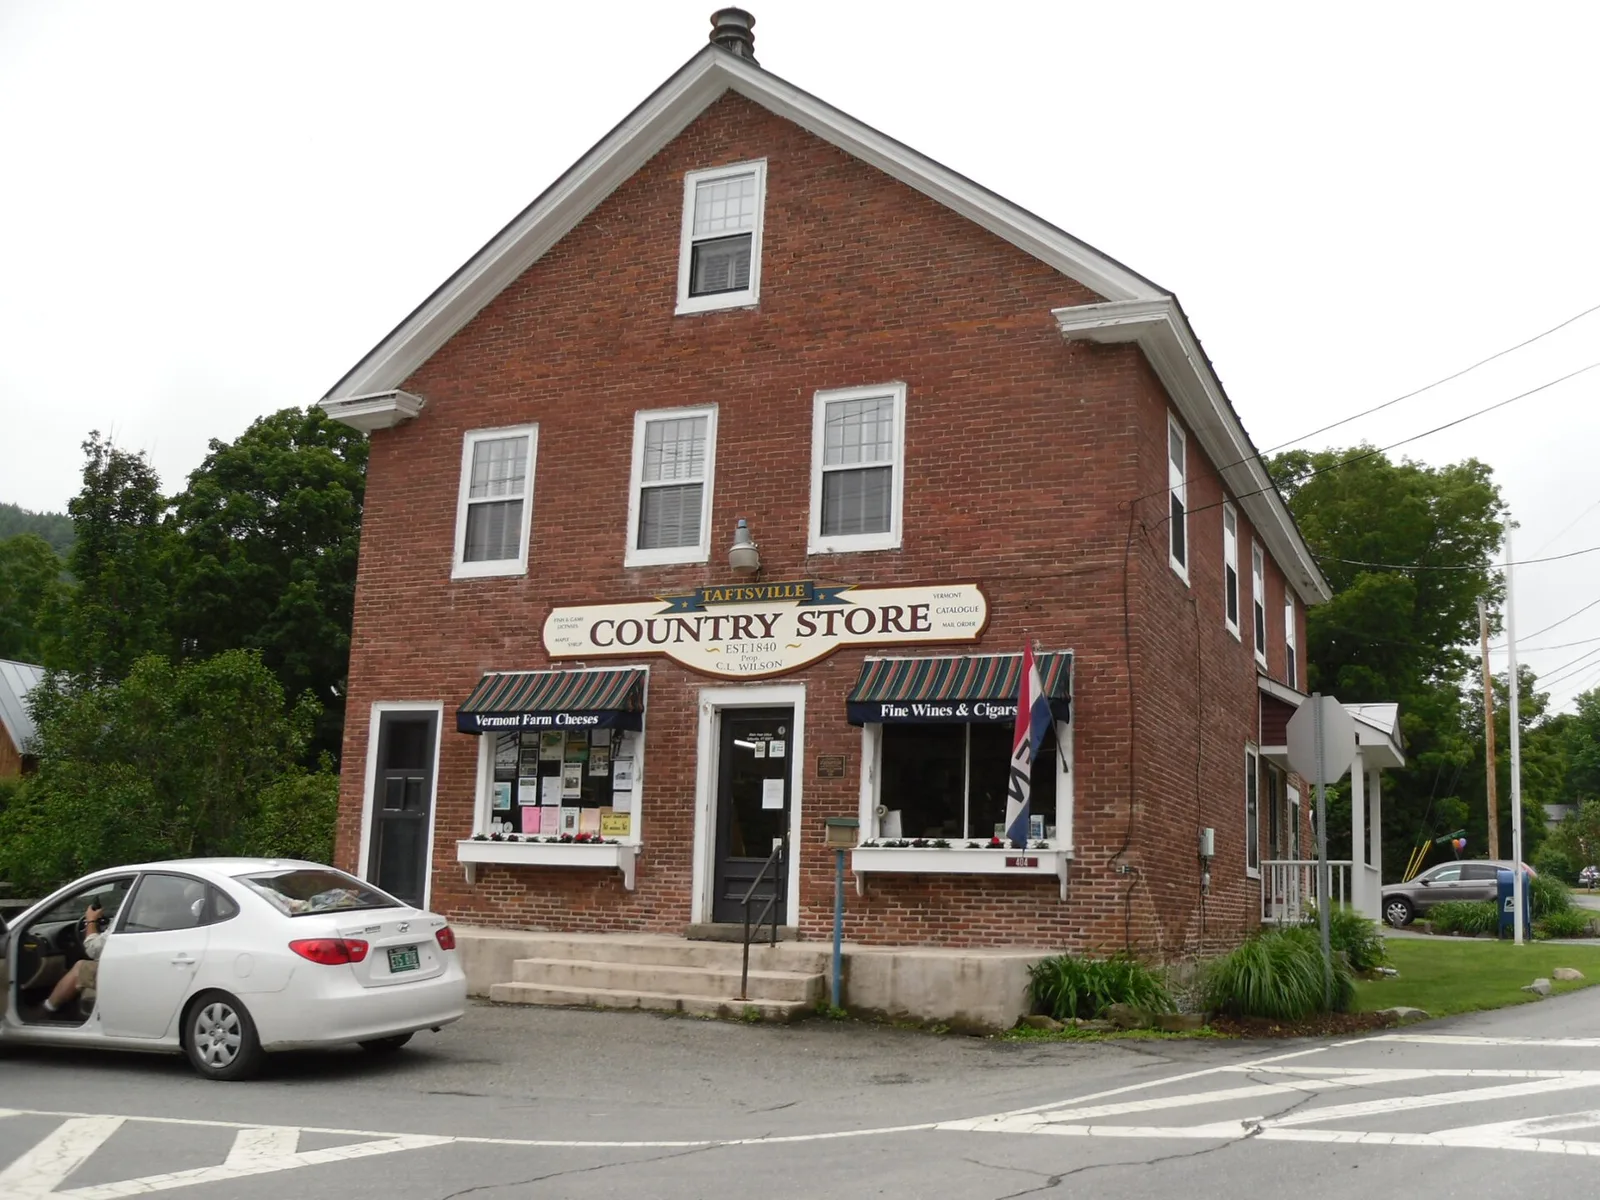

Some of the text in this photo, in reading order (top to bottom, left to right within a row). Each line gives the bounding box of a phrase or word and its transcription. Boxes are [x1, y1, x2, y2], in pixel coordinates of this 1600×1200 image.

[702, 584, 805, 602] TAFTSVILLE
[936, 605, 979, 614] CATALOGUE
[590, 603, 932, 647] COUNTRY STORE
[739, 660, 783, 671] WILSON
[880, 703, 1018, 720] Fine Wines & Cigars
[475, 713, 599, 726] Vermont Farm Cheeses
[1015, 857, 1028, 867] 404
